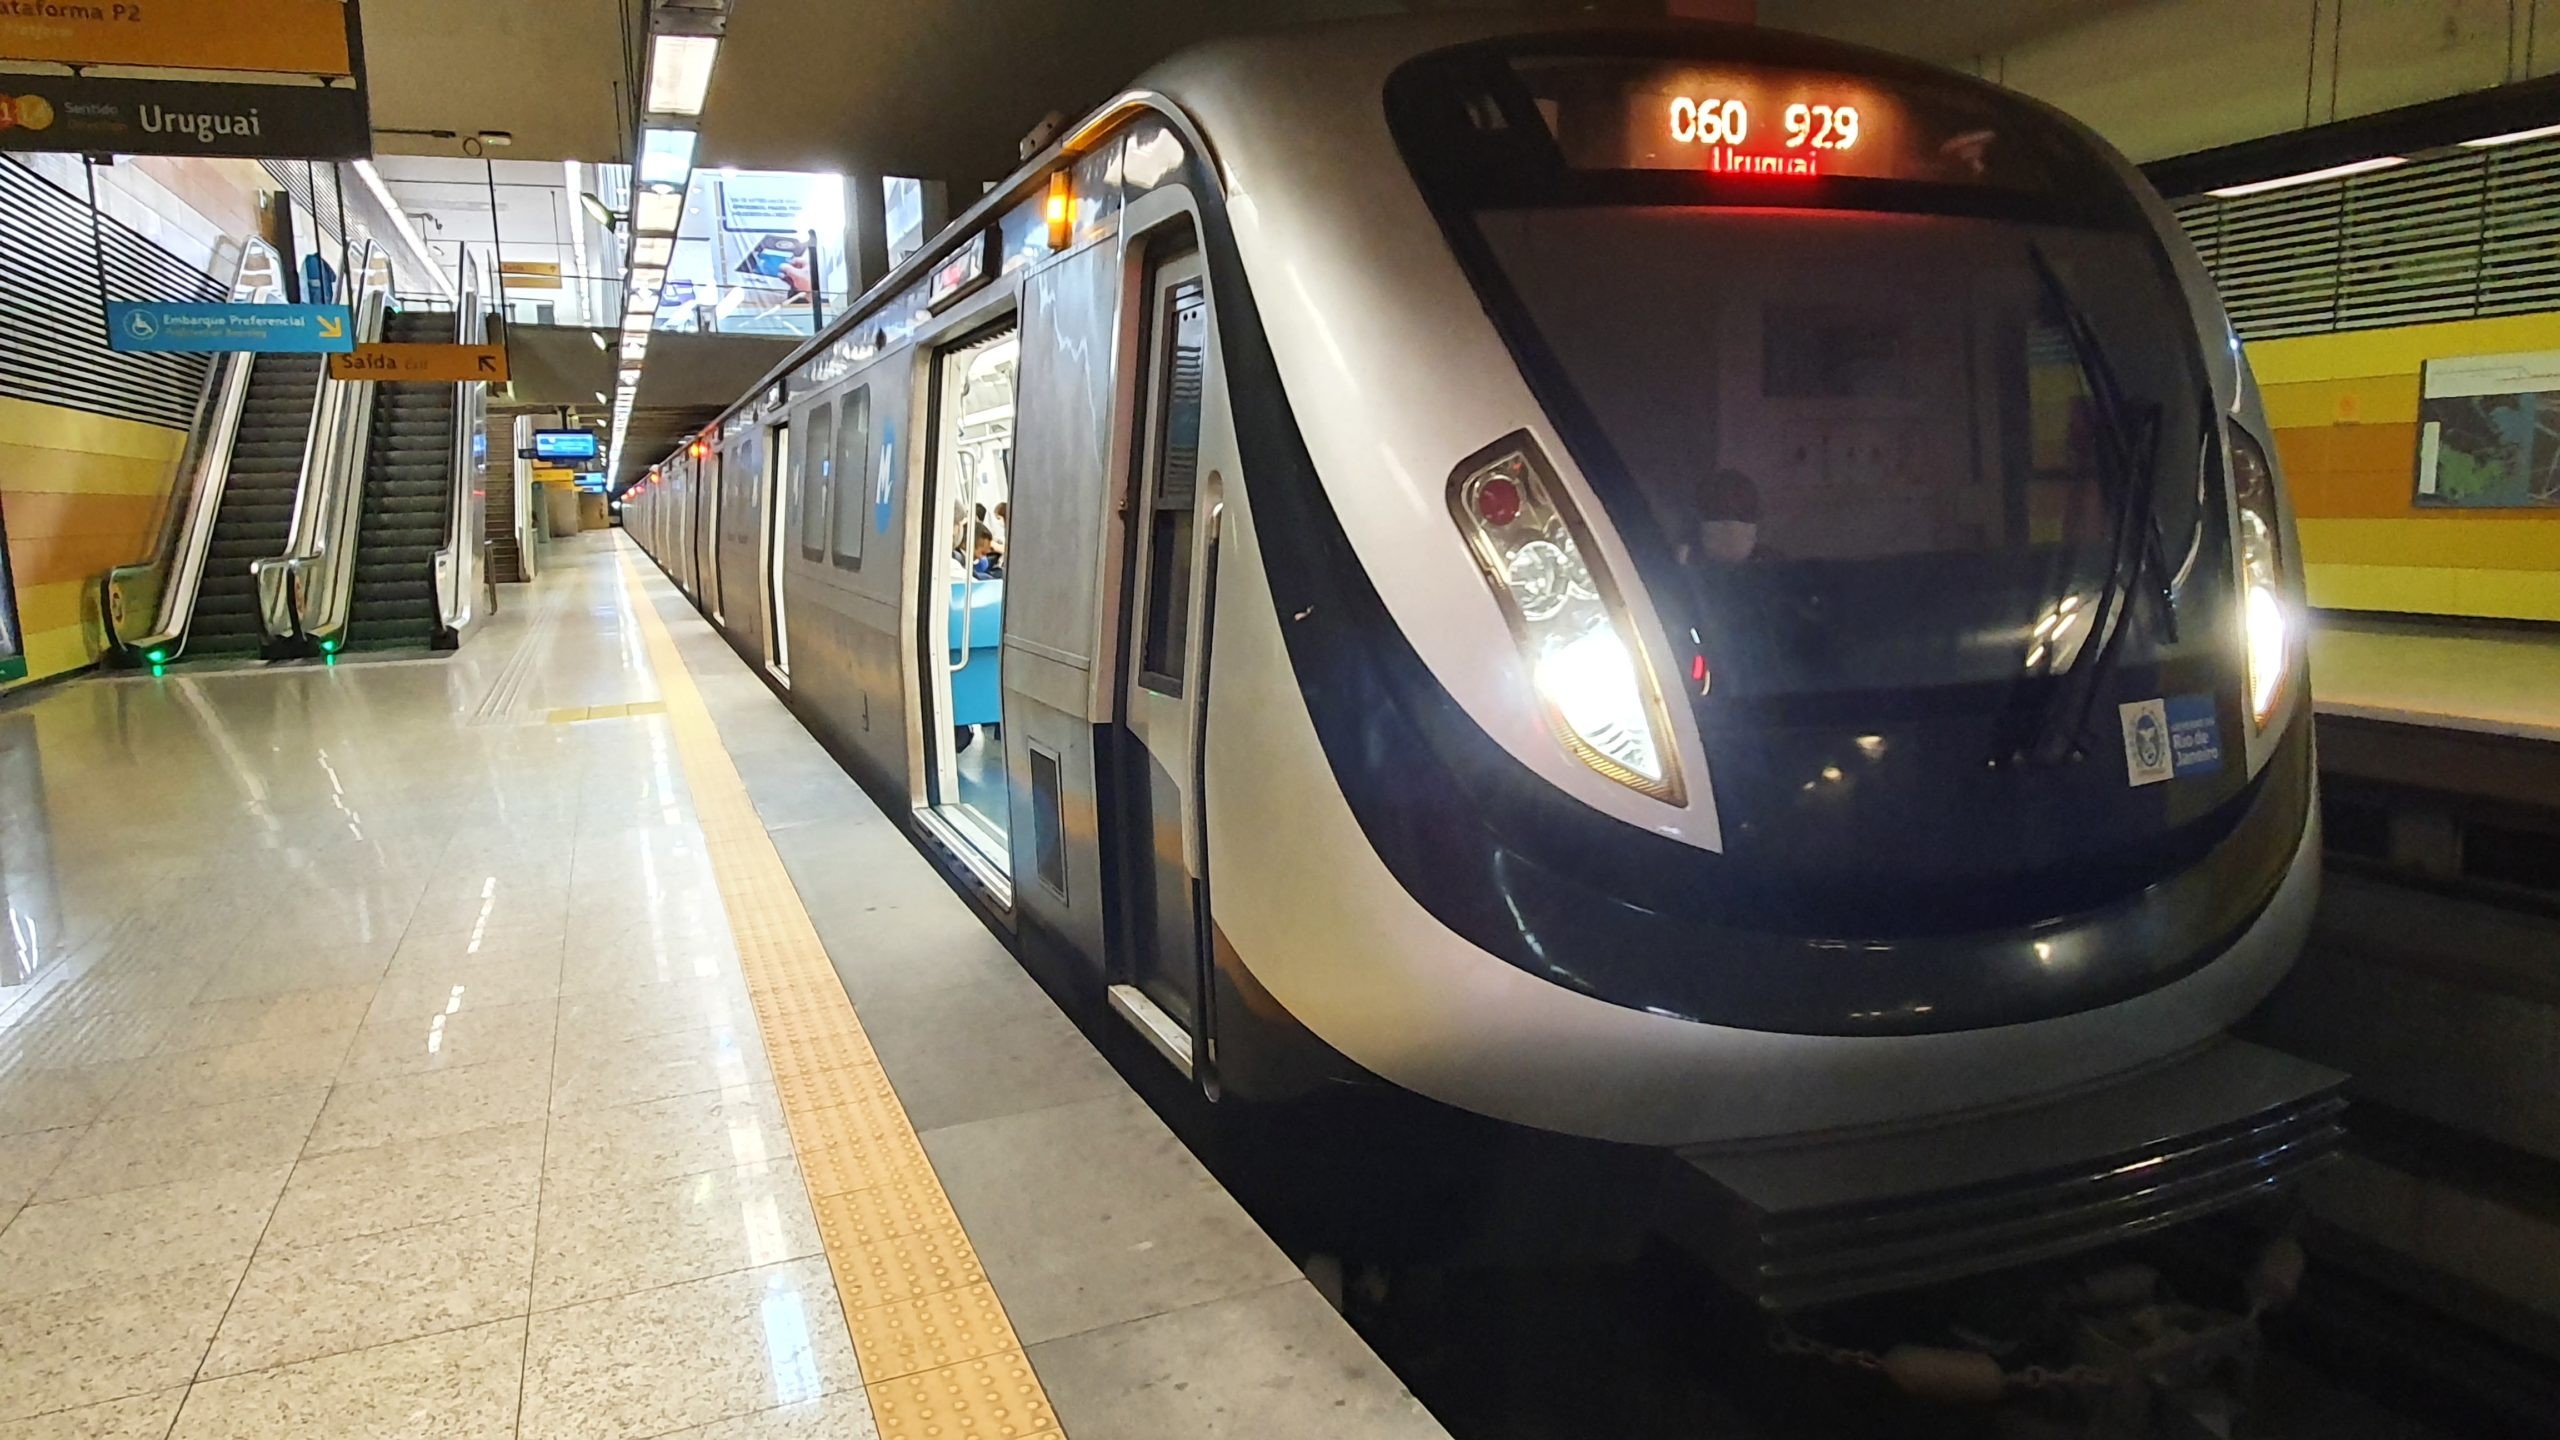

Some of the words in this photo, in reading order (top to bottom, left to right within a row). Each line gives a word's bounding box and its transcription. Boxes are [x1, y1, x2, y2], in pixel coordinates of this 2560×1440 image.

[112, 3, 141, 22] P2
[139, 104, 261, 143] Uruguai
[1670, 96, 1748, 145] 060
[1785, 103, 1860, 150] 929
[163, 314, 226, 328] Embarque
[229, 315, 305, 327] Preferencial
[341, 352, 397, 369] Saída
